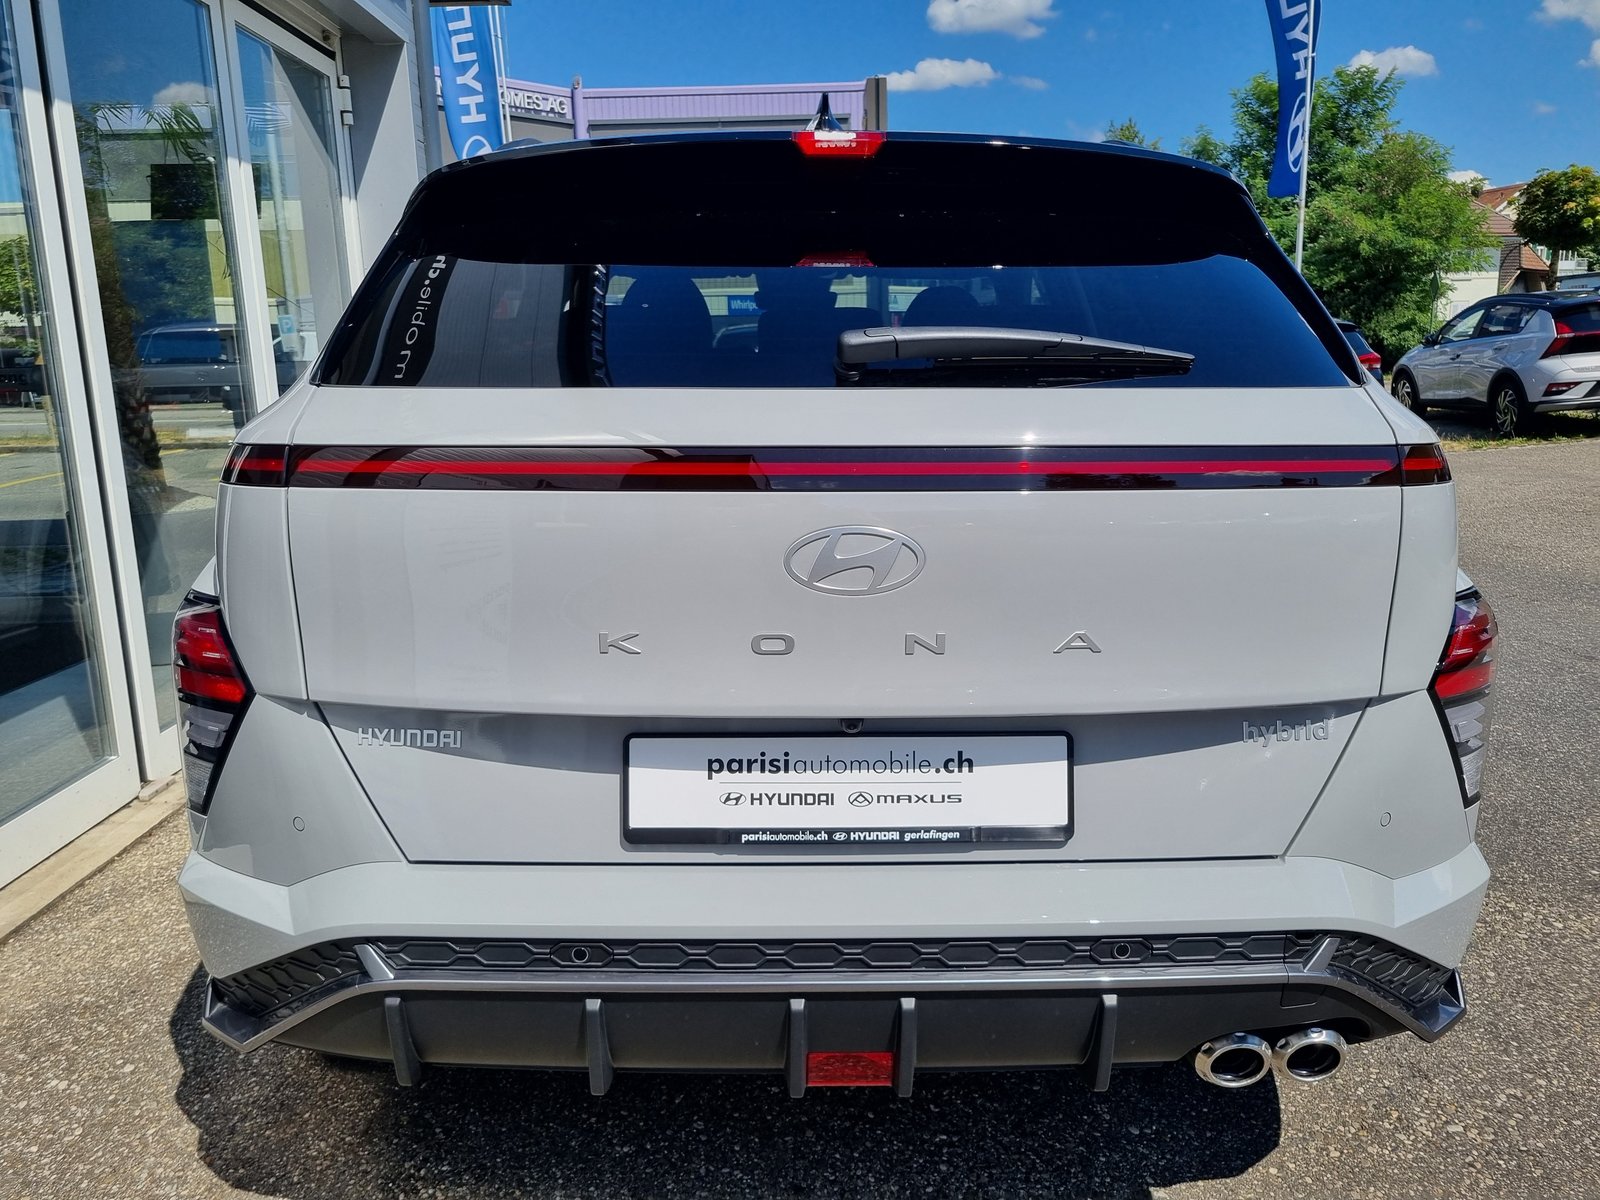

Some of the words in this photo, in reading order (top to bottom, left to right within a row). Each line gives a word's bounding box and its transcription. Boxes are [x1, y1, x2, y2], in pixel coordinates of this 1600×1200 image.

[546, 96, 568, 114] AG
[598, 630, 1103, 656] KONA
[358, 728, 462, 748] HYUNDAI
[1242, 719, 1330, 748] hybrid
[707, 750, 974, 780] parisiautomobile.ch
[750, 792, 835, 806] HYUNDAI
[876, 794, 963, 804] MAXUS
[741, 830, 828, 844] parisiautomobile.ch
[850, 831, 900, 841] HYUNDAI
[904, 829, 960, 842] gerlafingen
